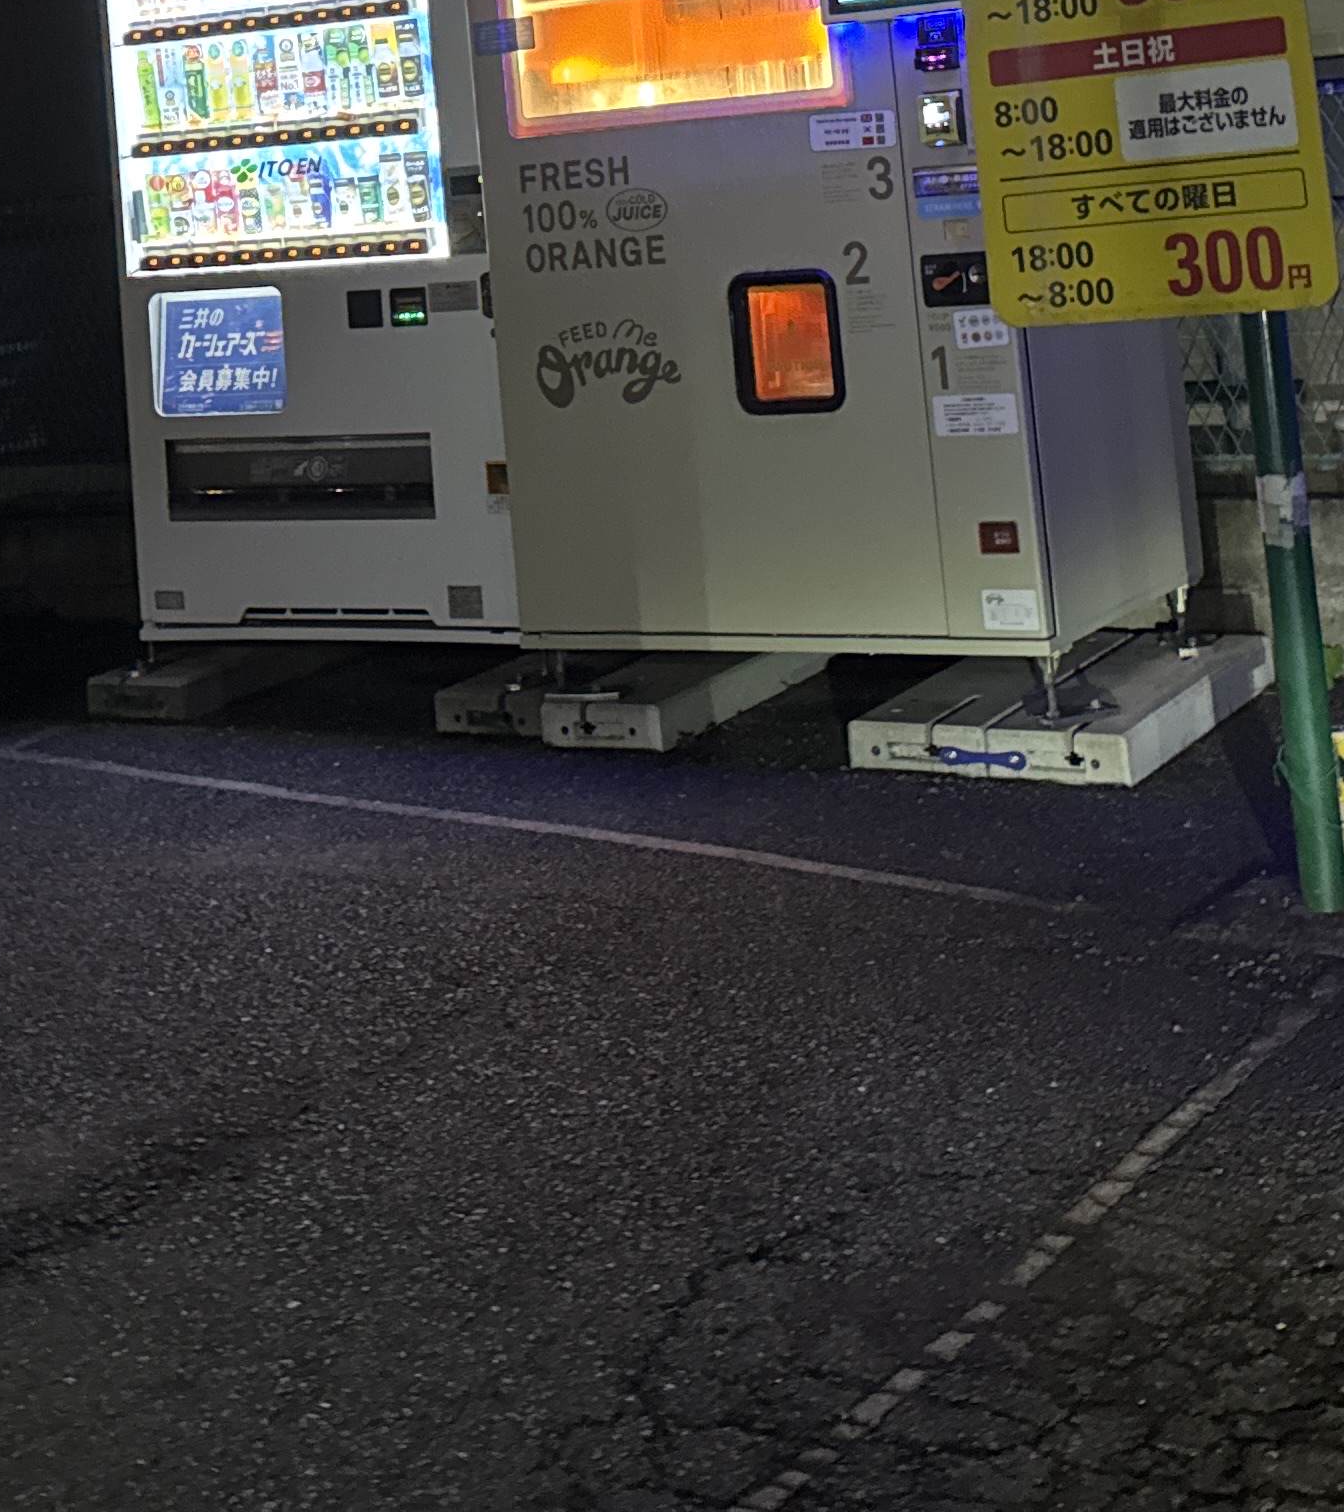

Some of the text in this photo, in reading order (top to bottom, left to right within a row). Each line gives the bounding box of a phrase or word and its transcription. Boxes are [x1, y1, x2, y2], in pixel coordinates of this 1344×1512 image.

[1093, 35, 1175, 70] 土日祝
[994, 96, 1059, 128] 8:00
[1159, 87, 1248, 114] 最大料金の
[1129, 106, 1286, 140] 適用はございません
[519, 156, 630, 193] FRESH
[867, 155, 894, 200] 3
[522, 200, 598, 233] 100%
[612, 204, 662, 221] JUICE
[1071, 182, 1237, 220] すべての曜日
[526, 235, 667, 273] ORANGE
[843, 241, 870, 285] 2
[1012, 241, 1094, 273] 18:00
[178, 307, 224, 330] 三井の
[558, 321, 607, 348] FEED
[536, 344, 682, 409] Orange
[931, 346, 949, 389] 1
